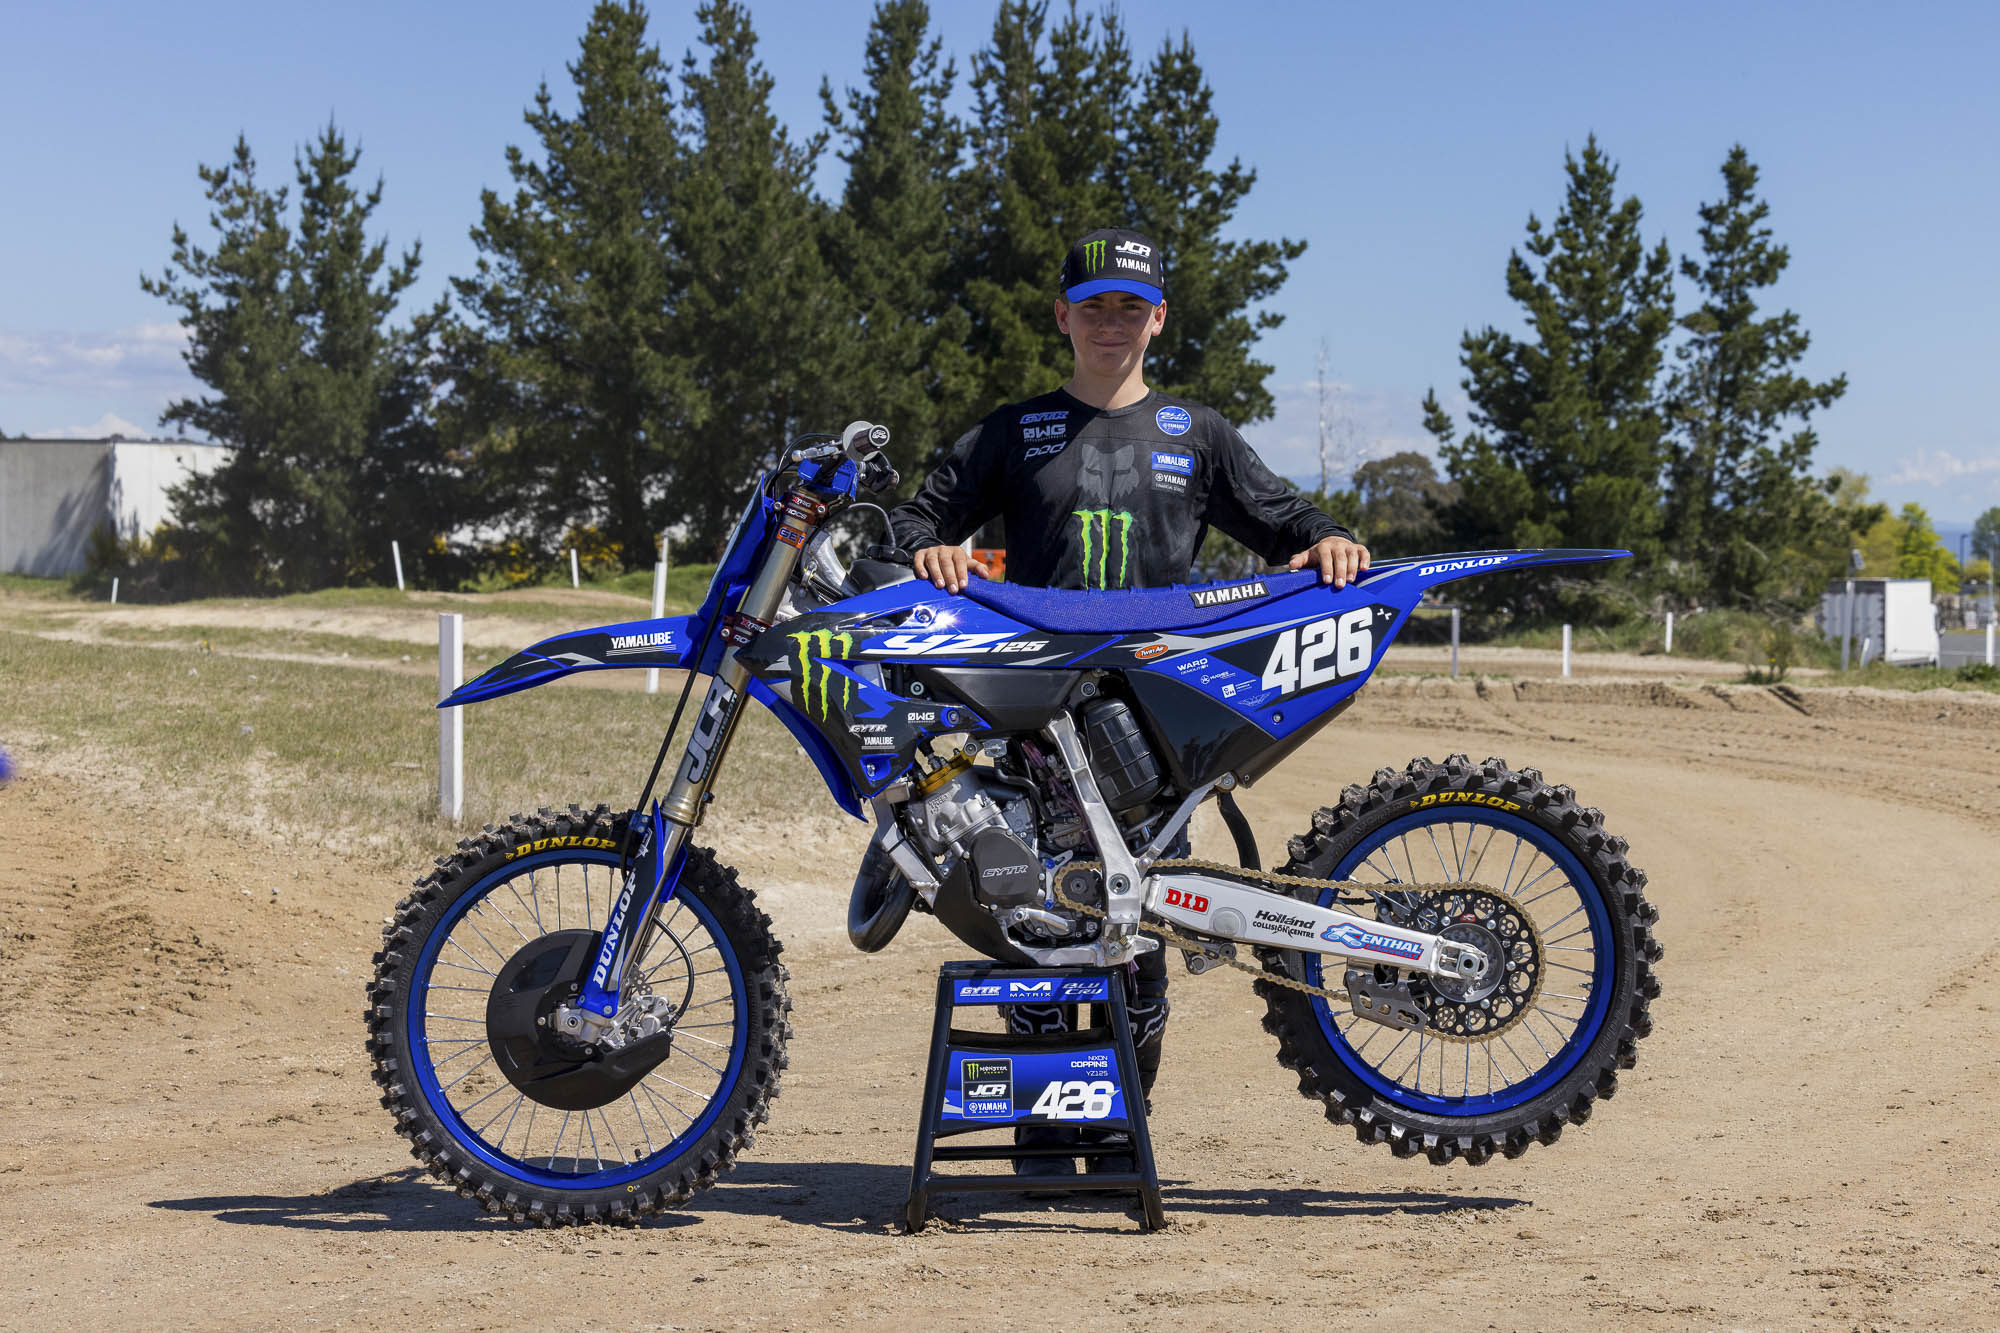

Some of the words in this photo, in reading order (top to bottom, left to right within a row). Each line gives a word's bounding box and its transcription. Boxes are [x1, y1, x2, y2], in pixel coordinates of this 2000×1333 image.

[1115, 241, 1152, 256] JCR
[1116, 258, 1150, 274] YAMAHA
[1020, 411, 1070, 424] GYTR
[1157, 455, 1190, 468] YAMALUBE
[780, 528, 805, 544] GET
[1418, 557, 1508, 576] DUNLOP
[1194, 582, 1265, 604] YAMAHA
[611, 631, 672, 649] YAMALUBE
[860, 632, 1019, 655] YZ
[990, 641, 1050, 653] 125
[1262, 606, 1373, 695] 426
[1177, 658, 1208, 671] WARD
[688, 673, 735, 784] JCR
[849, 724, 888, 732] GYTR
[864, 737, 894, 745] YAMALUBE
[1420, 792, 1520, 811] DUNLOP
[516, 835, 616, 857] DUNLOP
[983, 865, 1028, 878] GYTR
[1255, 910, 1316, 929] Holland
[593, 871, 636, 989] DUNLOP
[1253, 921, 1288, 934] COLLISION
[1290, 928, 1315, 939] CENTRE
[960, 986, 1001, 996] GYTR
[968, 1084, 1007, 1095] JCR
[978, 1102, 1007, 1110] YAMAHA
[1031, 1080, 1115, 1119] 426
